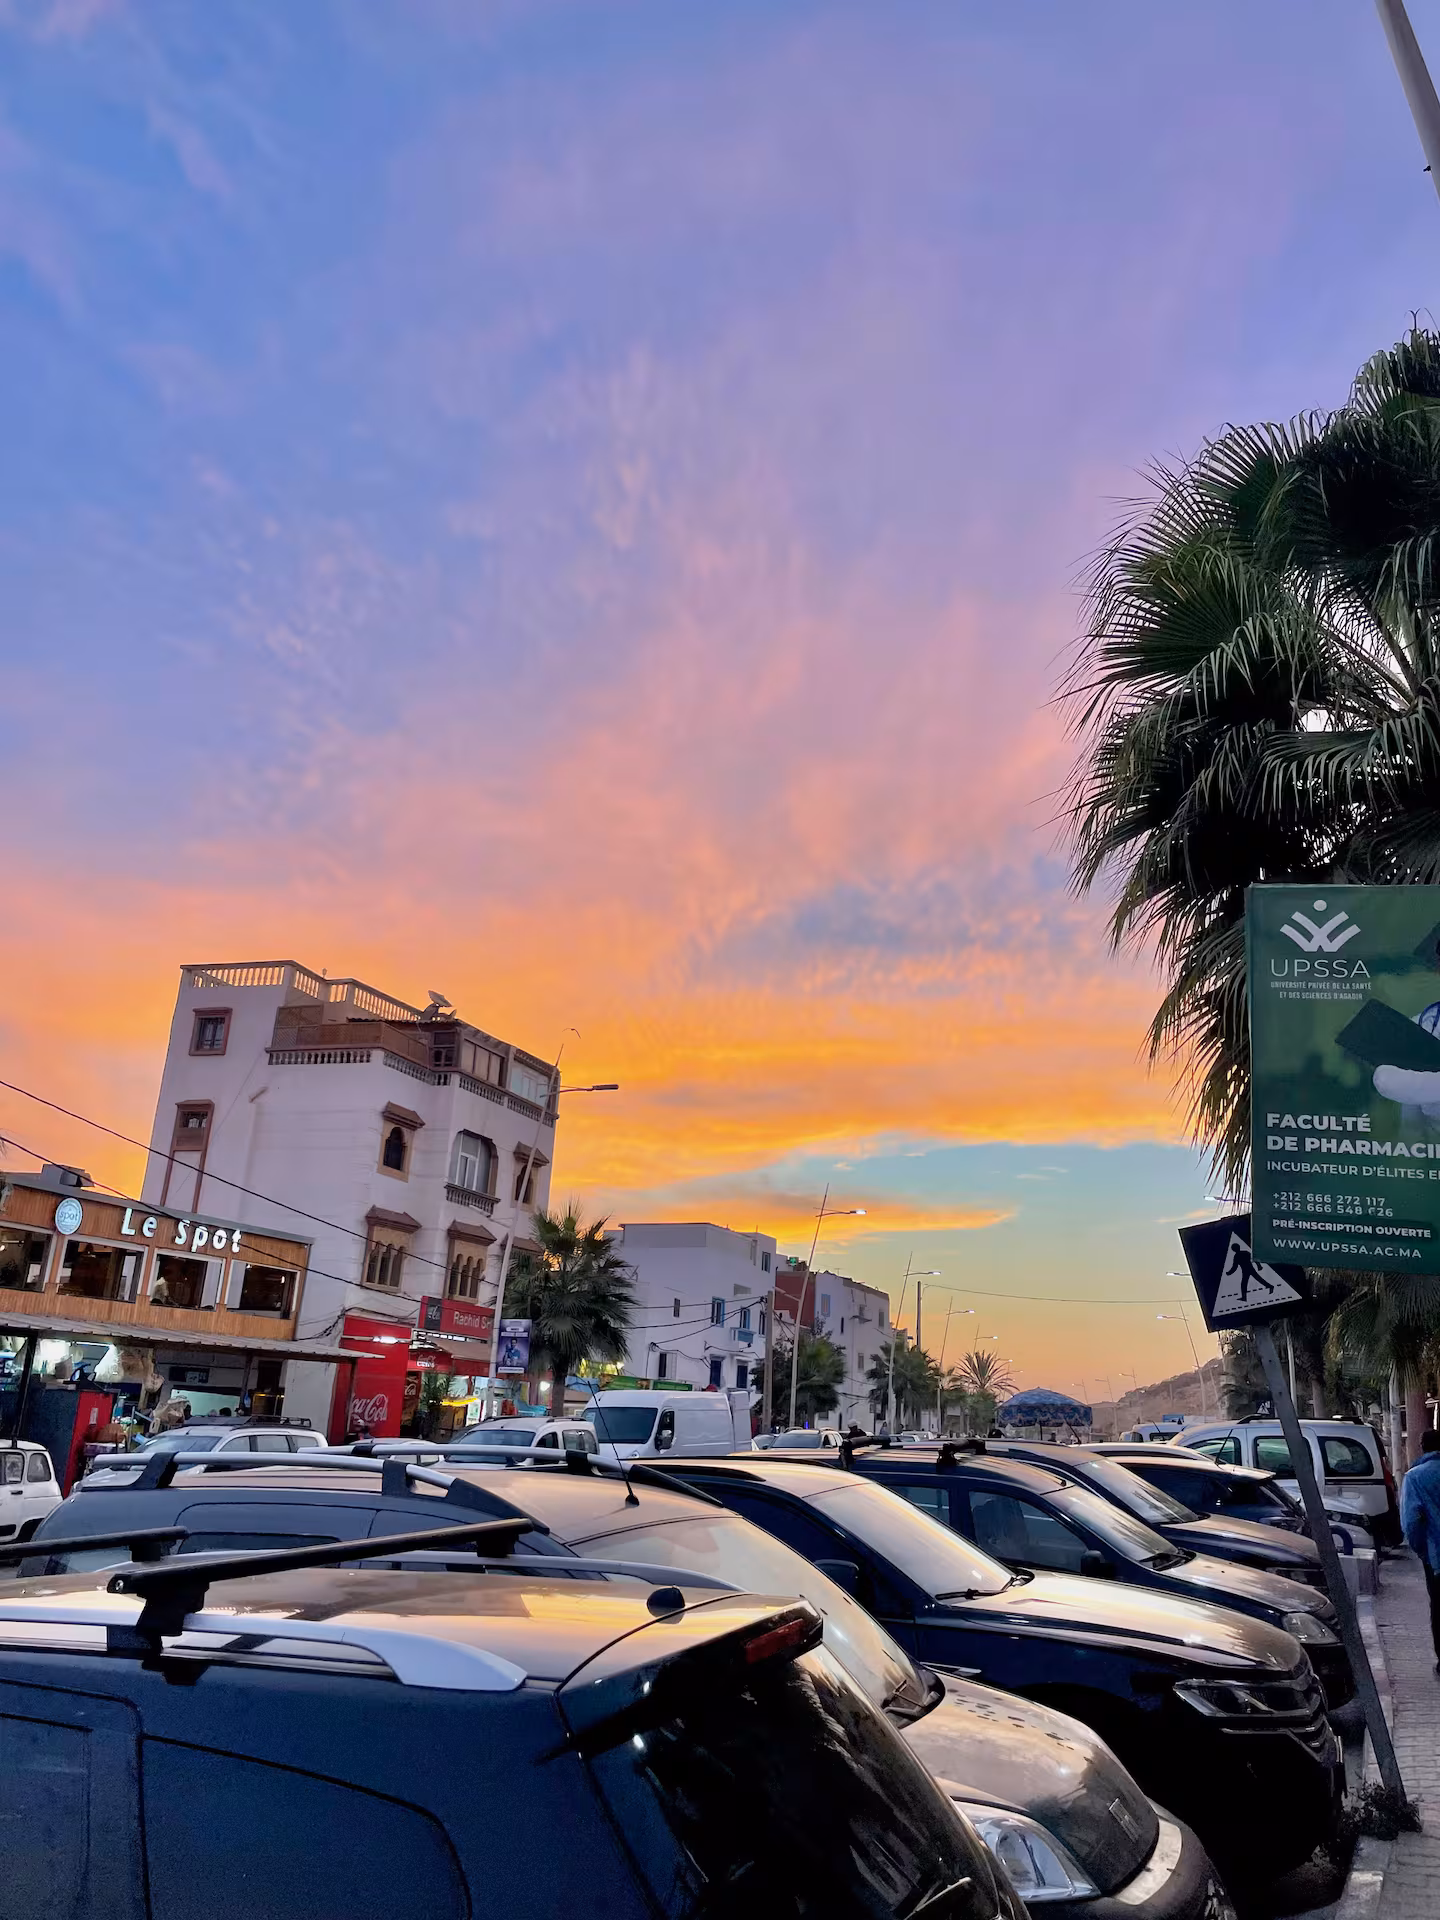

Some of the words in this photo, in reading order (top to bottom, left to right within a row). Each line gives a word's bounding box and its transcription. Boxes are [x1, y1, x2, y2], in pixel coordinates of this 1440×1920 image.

[1271, 958, 1371, 978] UPSSA
[1270, 981, 1306, 989] UNIVERSITÉ
[1332, 982, 1341, 990] DE
[1352, 982, 1372, 990] SANTÉ
[1279, 991, 1287, 999] ET
[1288, 991, 1300, 999] DES
[1301, 992, 1332, 1000] SCIENCES
[1333, 992, 1363, 1000] D'AGADIR
[1266, 1112, 1371, 1132] FACULTÉ
[1266, 1135, 1298, 1151] DE
[1267, 1160, 1358, 1175] INCUBATEUR
[1428, 1170, 1440, 1180] E
[1273, 1191, 1301, 1201] +212
[1306, 1193, 1332, 1203] 666
[1336, 1195, 1361, 1205] 272
[1365, 1197, 1386, 1206] 117
[1273, 1201, 1301, 1211] +212
[1306, 1203, 1332, 1213] 666
[1336, 1205, 1363, 1215] 548
[121, 1207, 158, 1238] Le
[174, 1219, 242, 1253] Spot
[1272, 1218, 1373, 1234] PRÉ-INSCRIPTION
[1375, 1226, 1432, 1238] OUVERTE
[1272, 1238, 1422, 1258] WWW.UPSSA.AC.MA
[453, 1311, 481, 1328] Rachid
